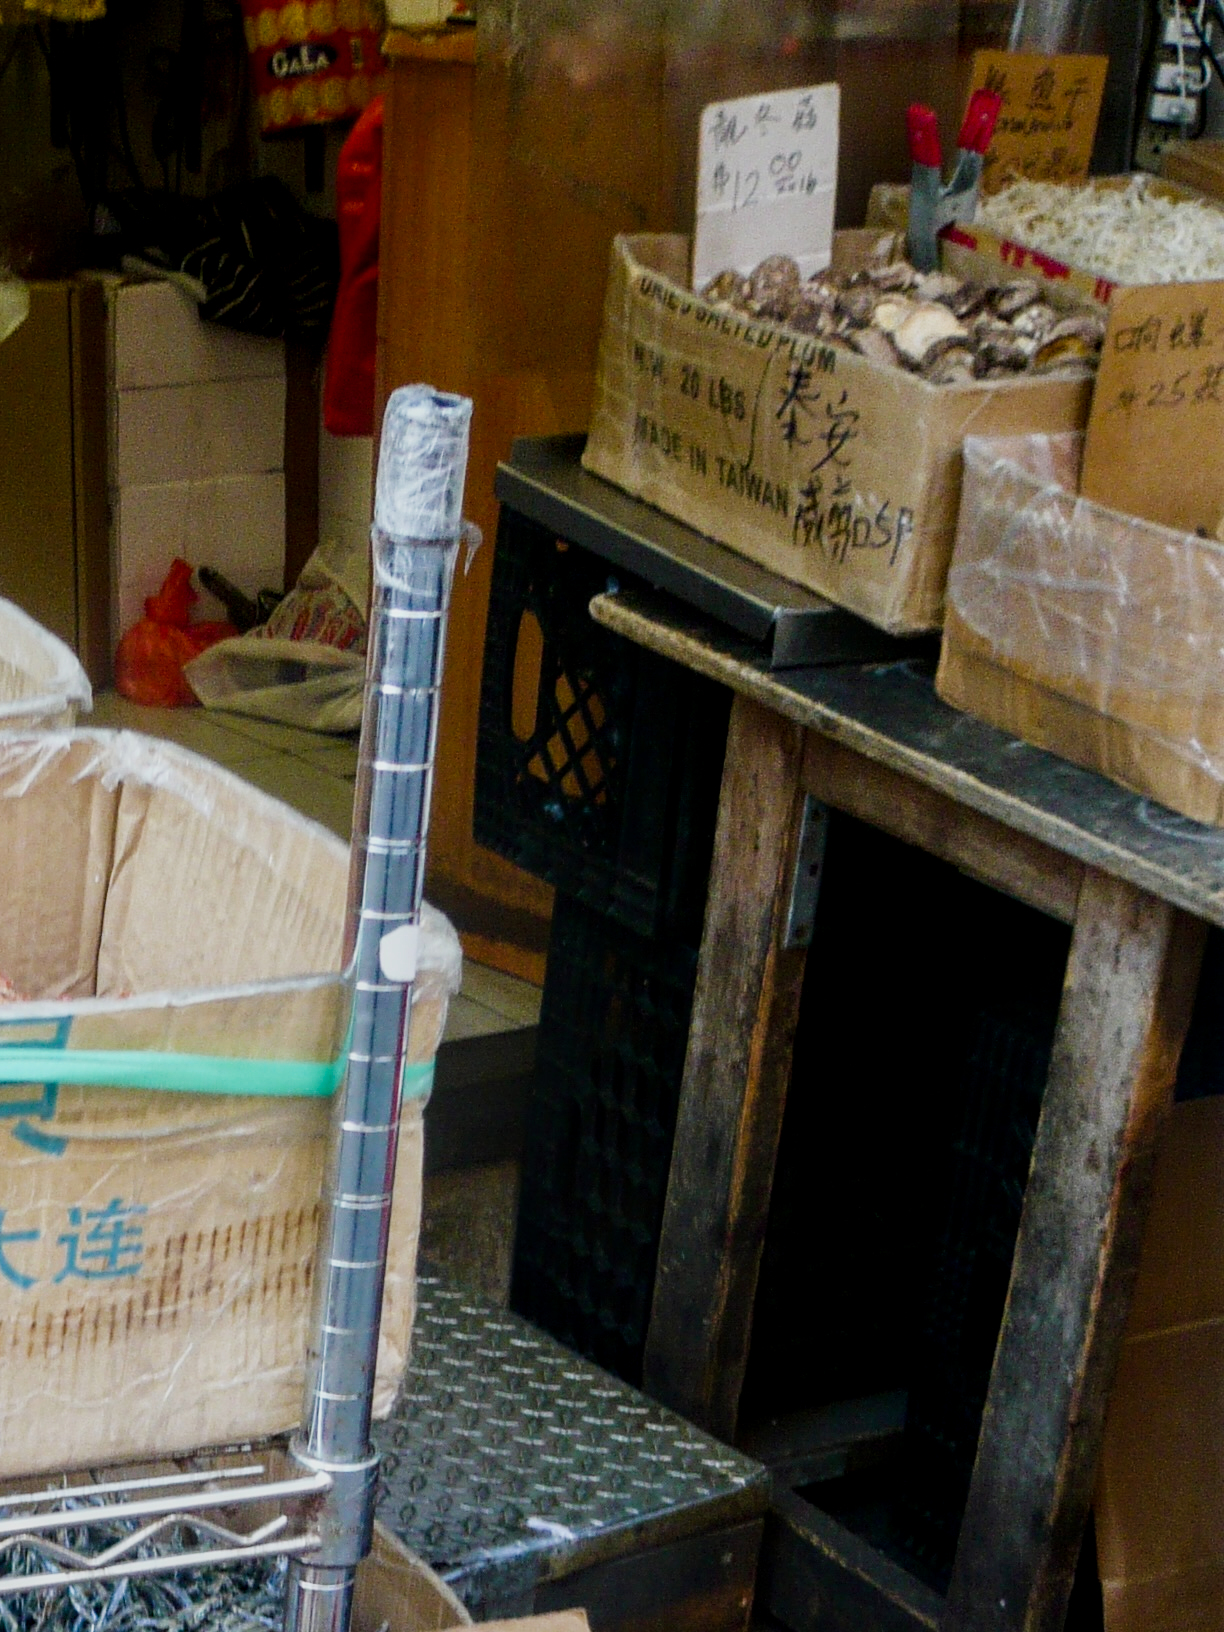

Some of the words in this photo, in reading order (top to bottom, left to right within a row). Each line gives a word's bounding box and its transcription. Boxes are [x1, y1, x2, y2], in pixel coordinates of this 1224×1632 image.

[679, 364, 701, 400] 20
[708, 376, 746, 422] LBS
[715, 456, 790, 518] TAIWAN
